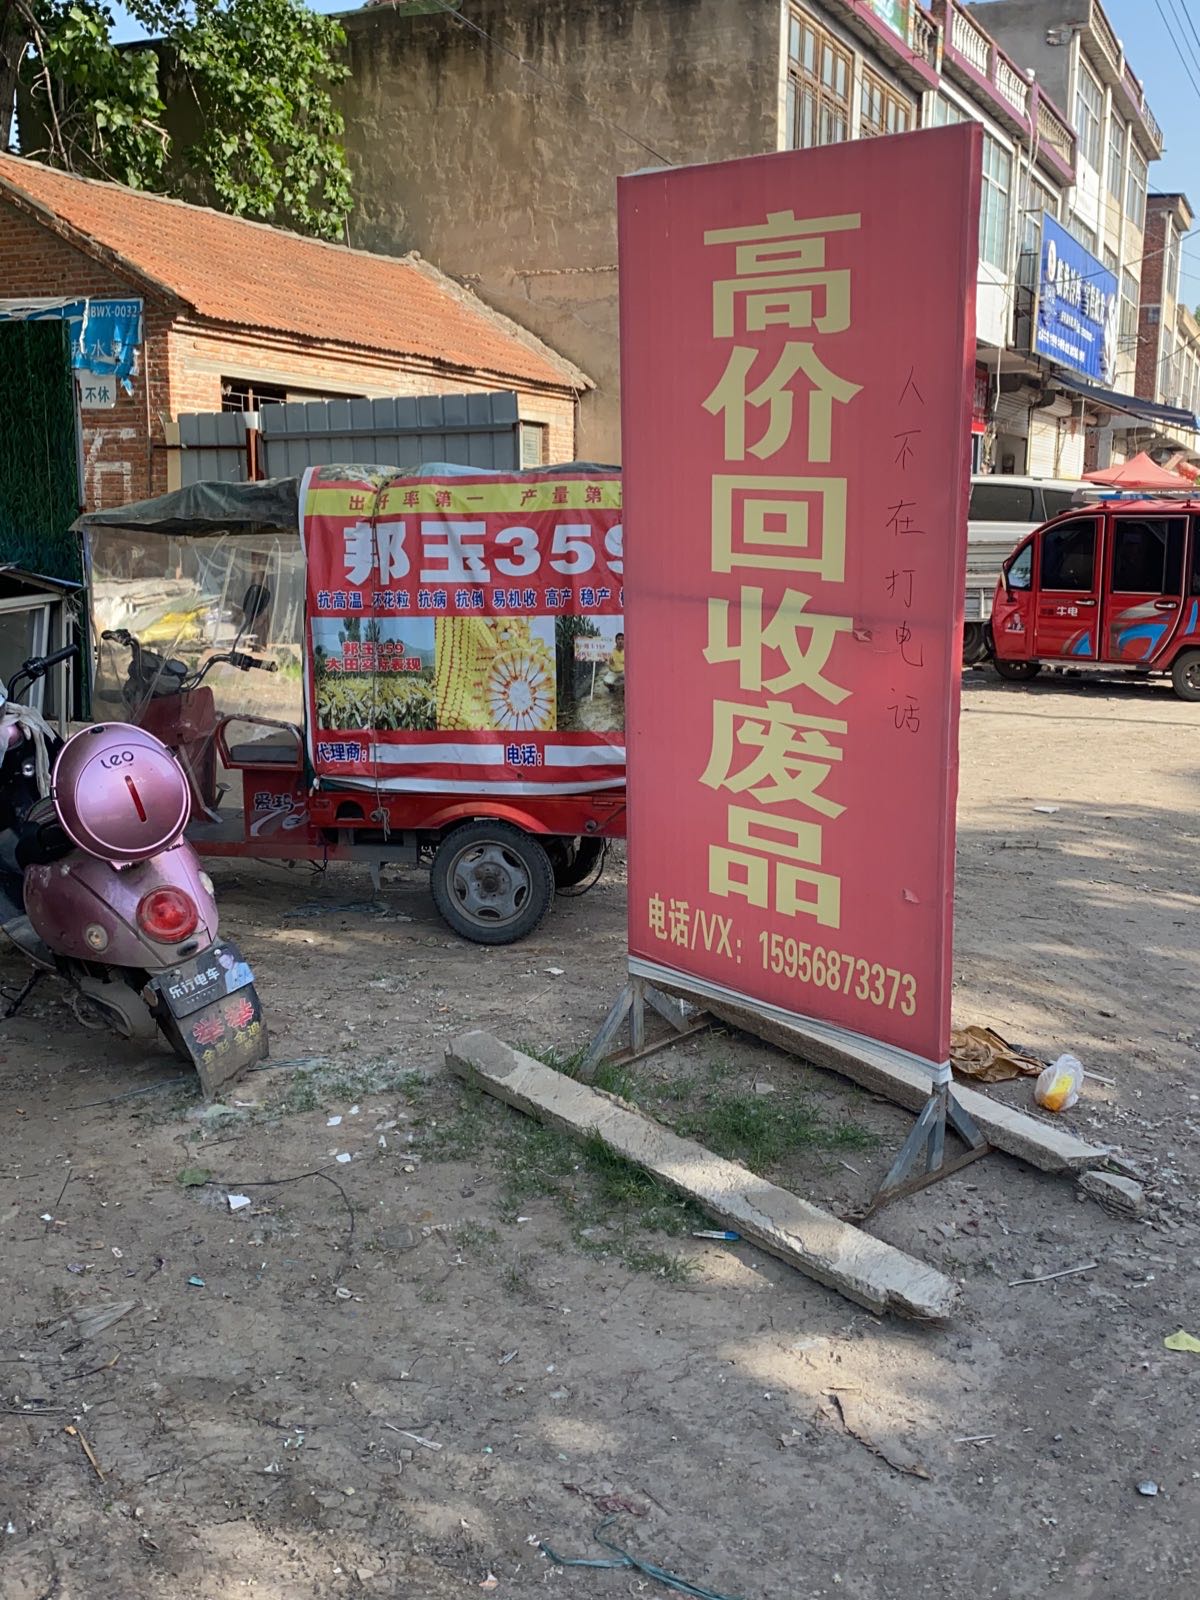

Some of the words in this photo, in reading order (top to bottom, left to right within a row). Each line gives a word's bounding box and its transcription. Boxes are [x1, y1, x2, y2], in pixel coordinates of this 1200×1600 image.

[520, 485, 622, 507] 产量第
[885, 365, 925, 733] 人不在打电话
[699, 209, 864, 929] 高价回收废品
[317, 590, 363, 609] 抗高温
[417, 589, 447, 608] 抗病
[455, 589, 484, 608] 抗倒
[492, 589, 537, 608] 易机收
[545, 588, 572, 608] 高产
[580, 588, 611, 608] 稳产
[168, 966, 220, 999] 乐行电车
